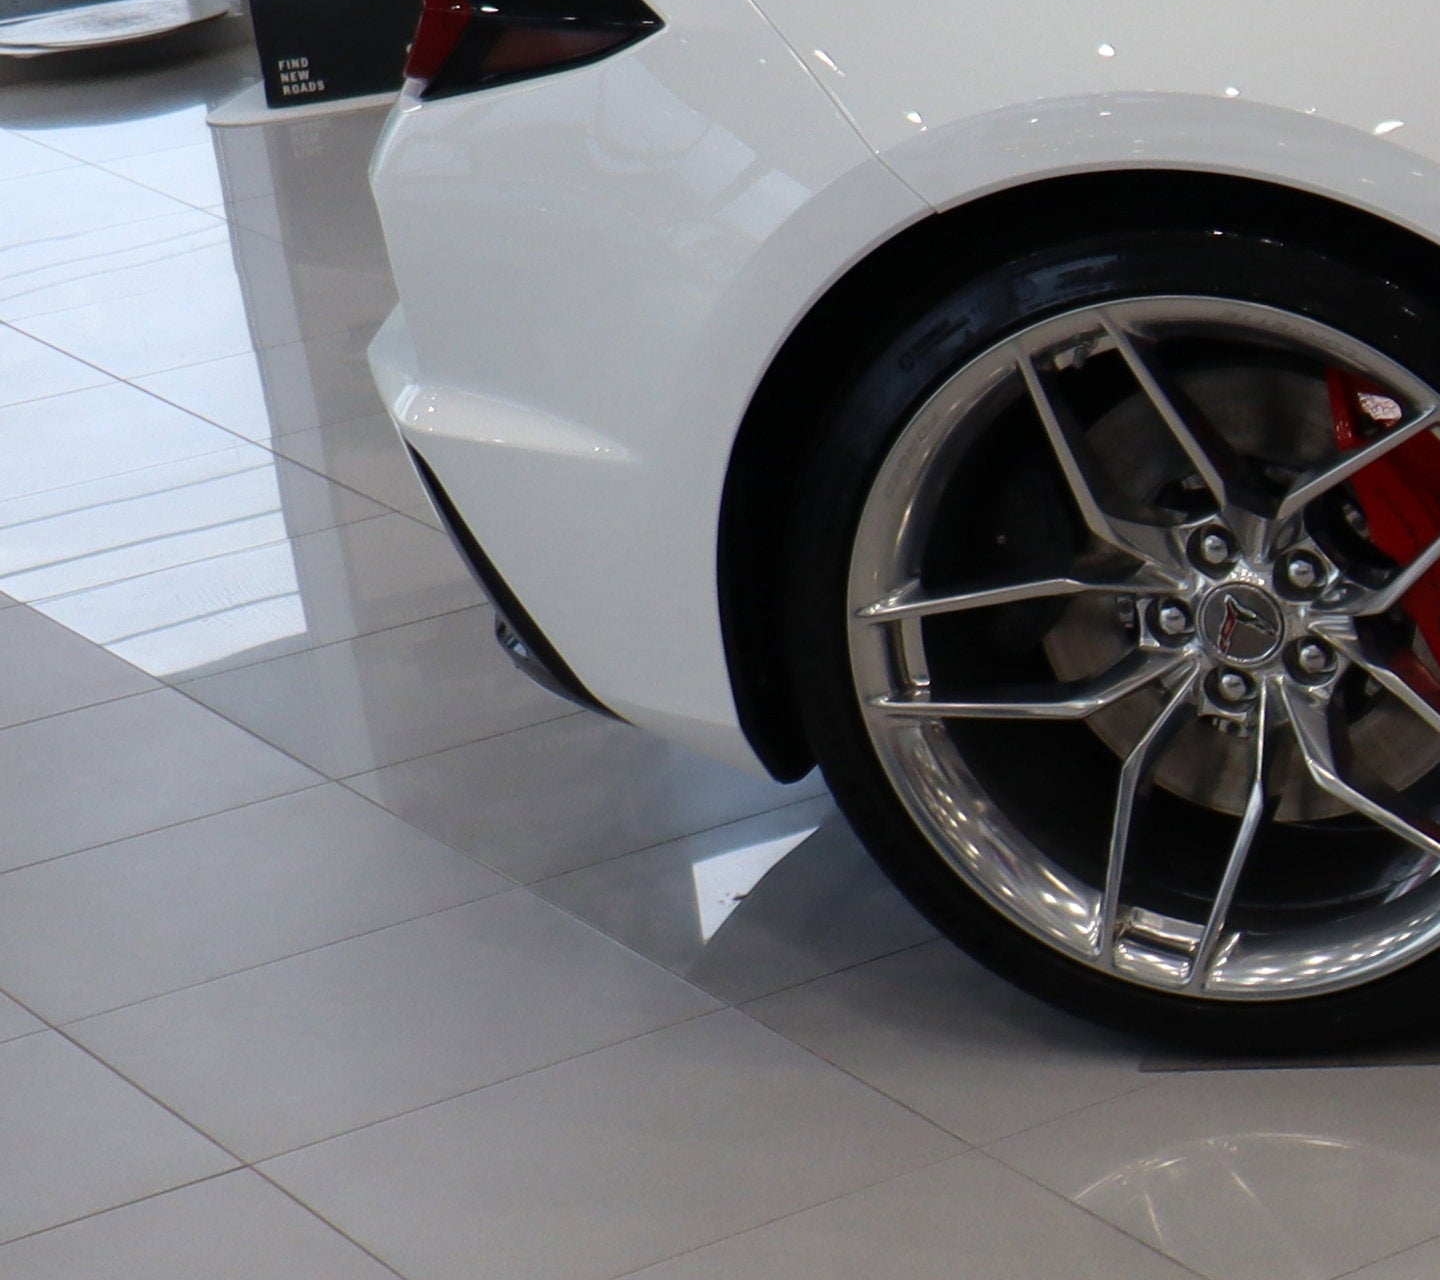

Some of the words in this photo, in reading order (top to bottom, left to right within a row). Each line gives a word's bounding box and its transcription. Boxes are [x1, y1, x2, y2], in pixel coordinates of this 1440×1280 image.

[278, 57, 309, 70] FIND
[280, 69, 310, 82] NEW
[282, 80, 326, 96] ROADS
